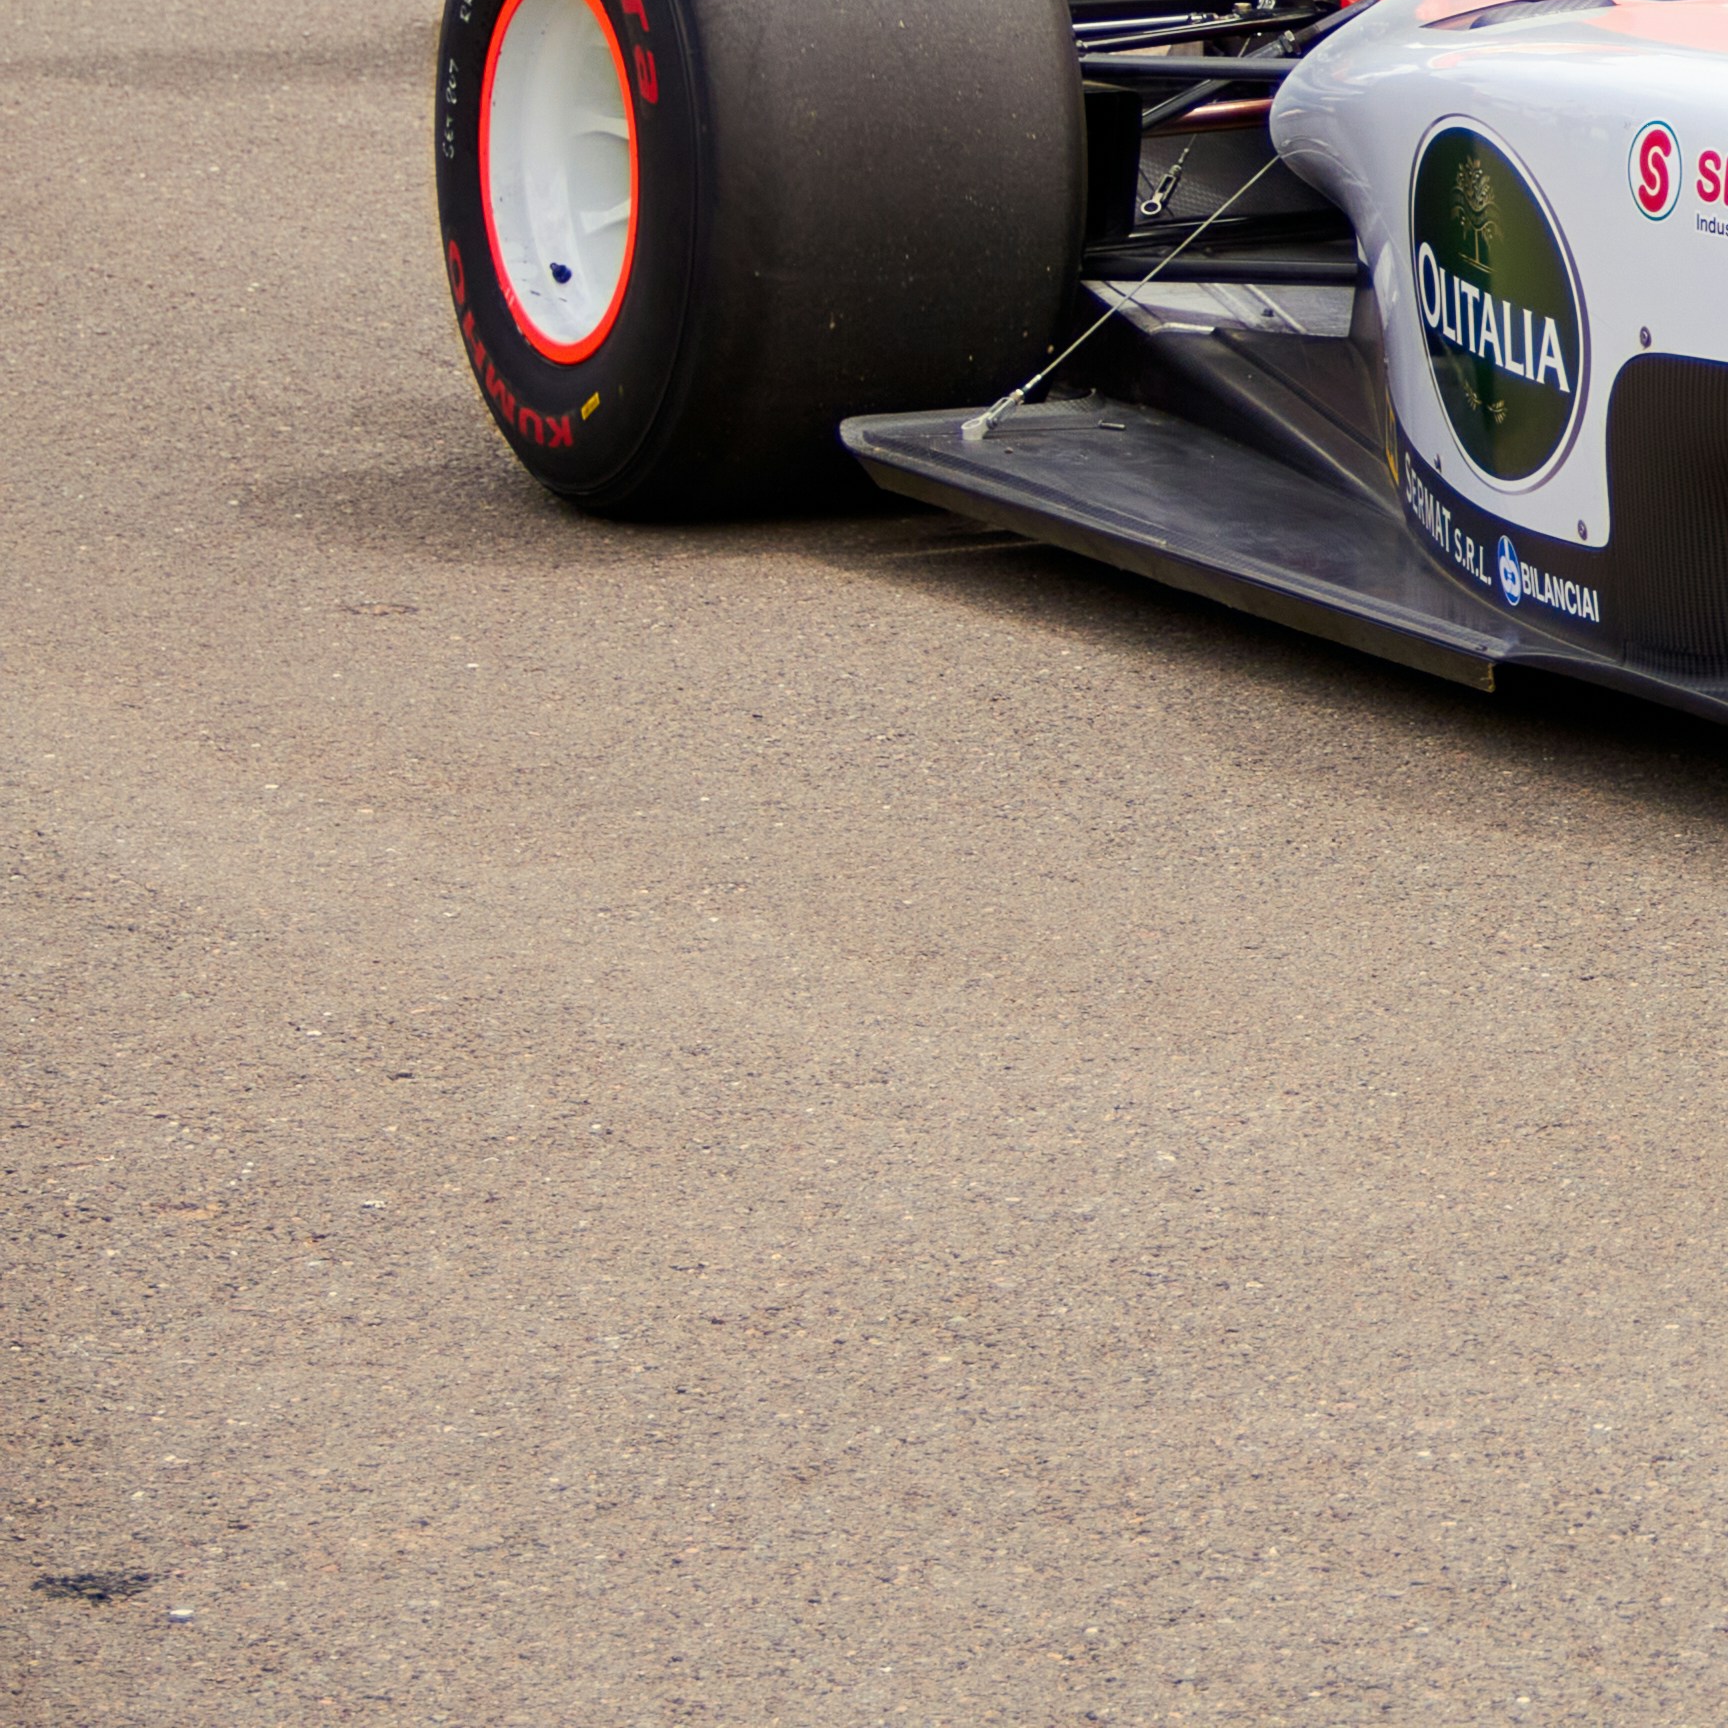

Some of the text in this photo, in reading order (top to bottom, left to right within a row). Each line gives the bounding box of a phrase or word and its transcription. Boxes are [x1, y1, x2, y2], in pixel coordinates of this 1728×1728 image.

[1640, 129, 1672, 212] S
[448, 240, 574, 448] KUMHO
[1417, 242, 1570, 394] OLITALIA
[1404, 452, 1492, 586] SERMAT S.R.L.
[1521, 562, 1600, 623] BILANCIAI
